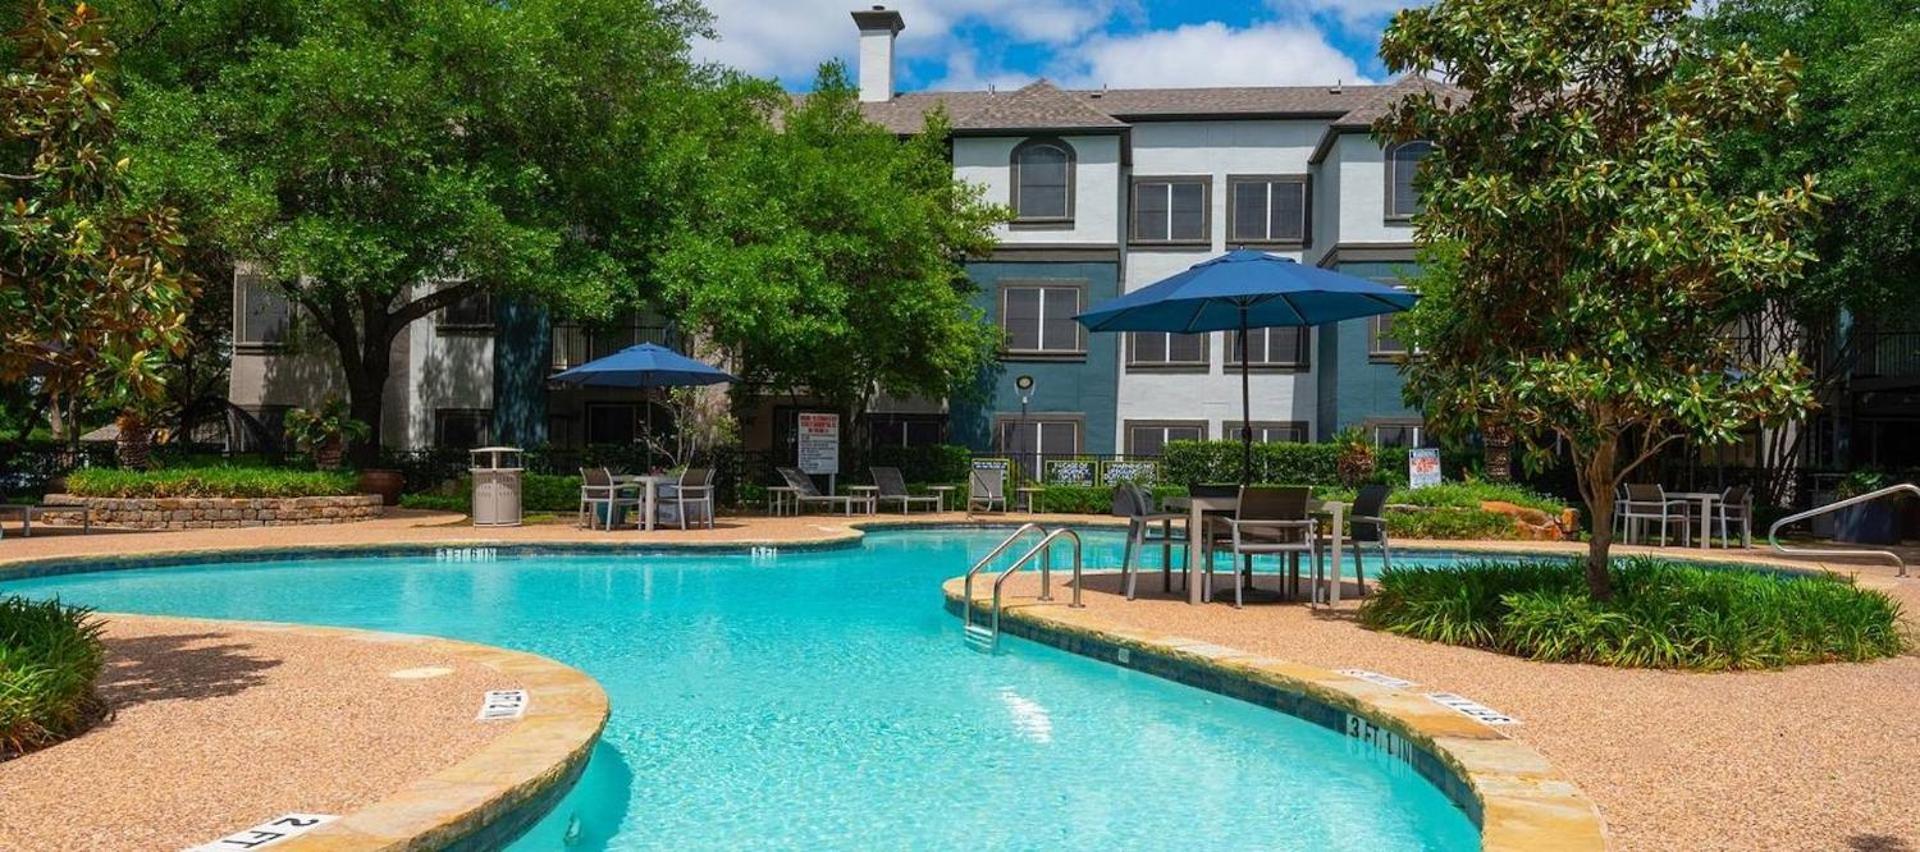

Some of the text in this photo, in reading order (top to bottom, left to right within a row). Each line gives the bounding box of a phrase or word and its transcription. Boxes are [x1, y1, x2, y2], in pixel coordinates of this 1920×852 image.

[1350, 717, 1359, 738] 3
[1387, 732, 1392, 755] 1
[221, 817, 320, 849] 2 FT
